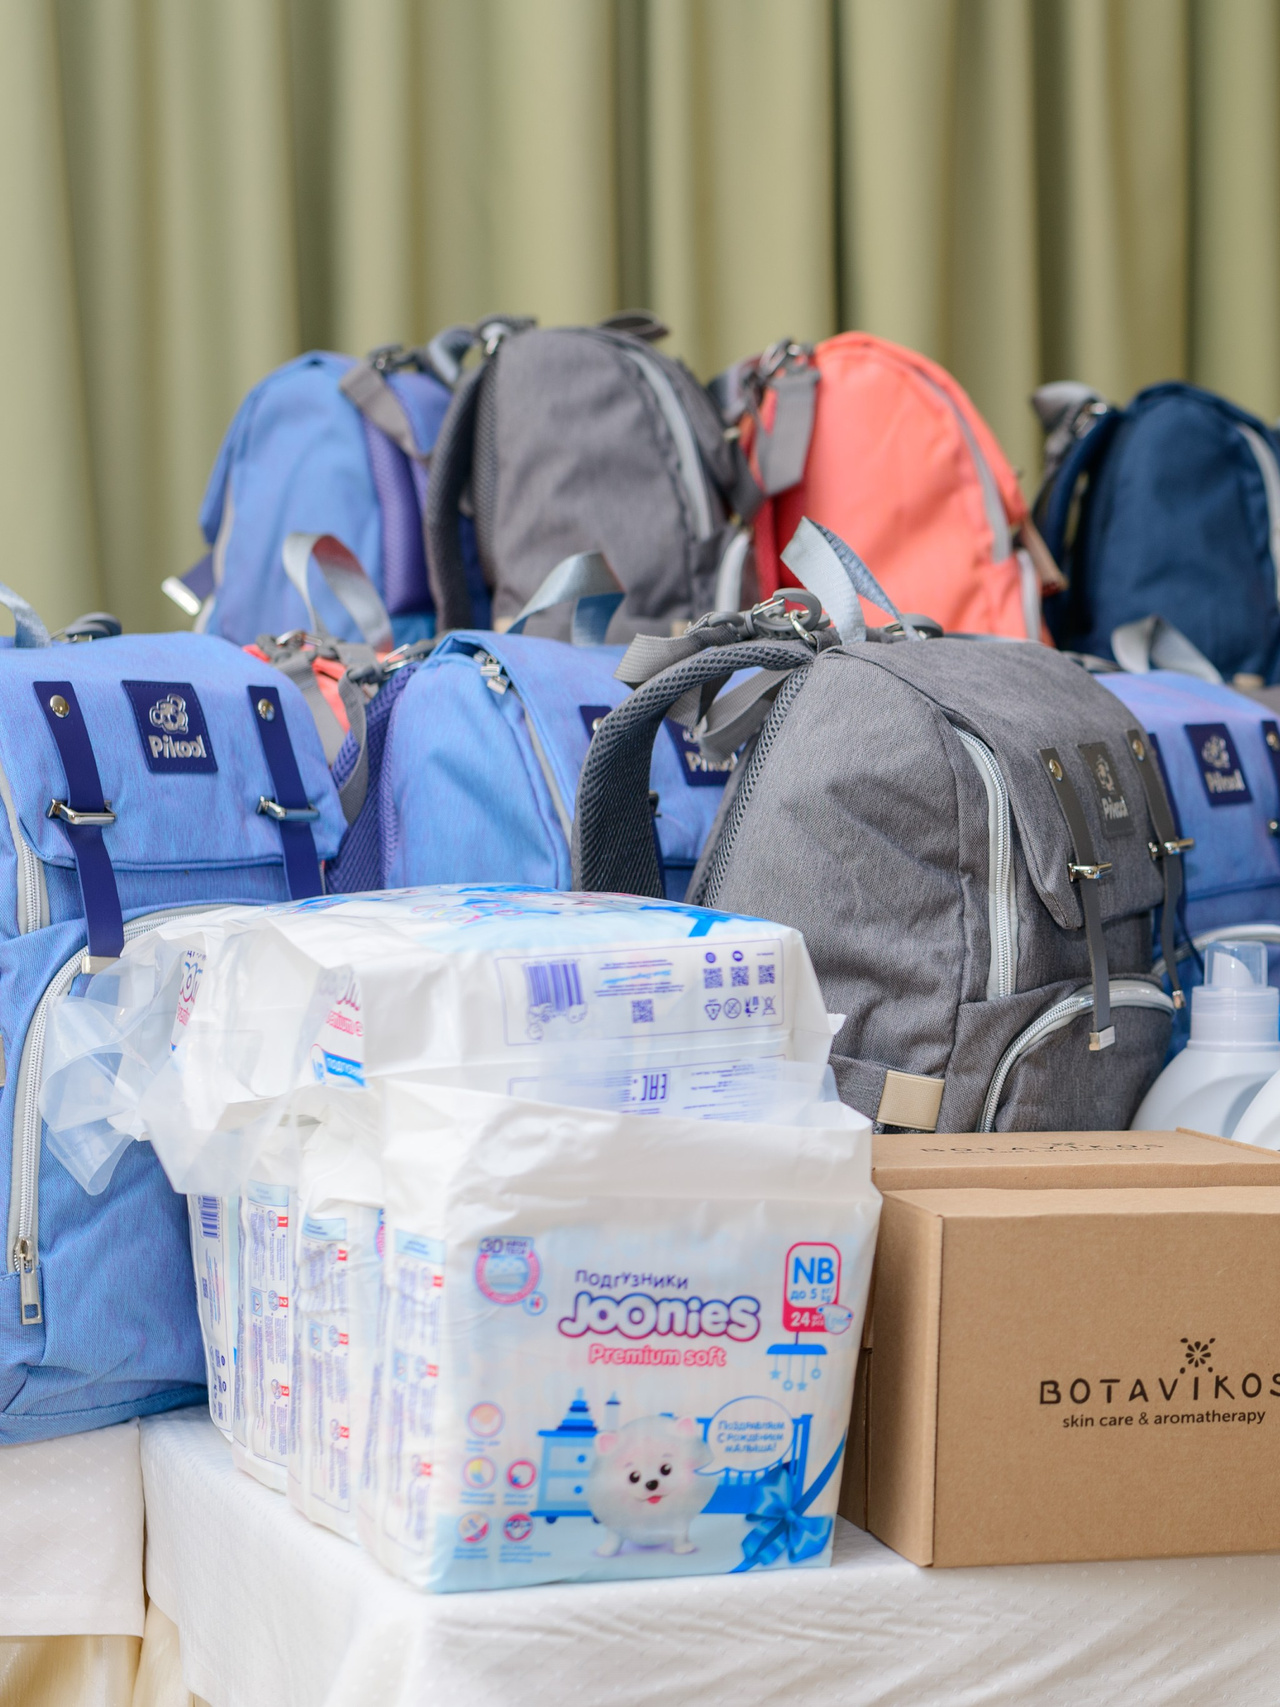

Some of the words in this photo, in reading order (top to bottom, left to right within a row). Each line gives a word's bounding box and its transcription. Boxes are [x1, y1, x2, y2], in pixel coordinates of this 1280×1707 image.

[148, 734, 207, 759] Pikool
[793, 1256, 835, 1285] NB
[790, 1311, 810, 1327] 24
[588, 1343, 681, 1365] Premium
[683, 1346, 727, 1367] soft
[1062, 1413, 1094, 1428] skin
[1099, 1413, 1133, 1427] care
[1138, 1412, 1150, 1425] &
[1153, 1409, 1266, 1425] aromatherapy
